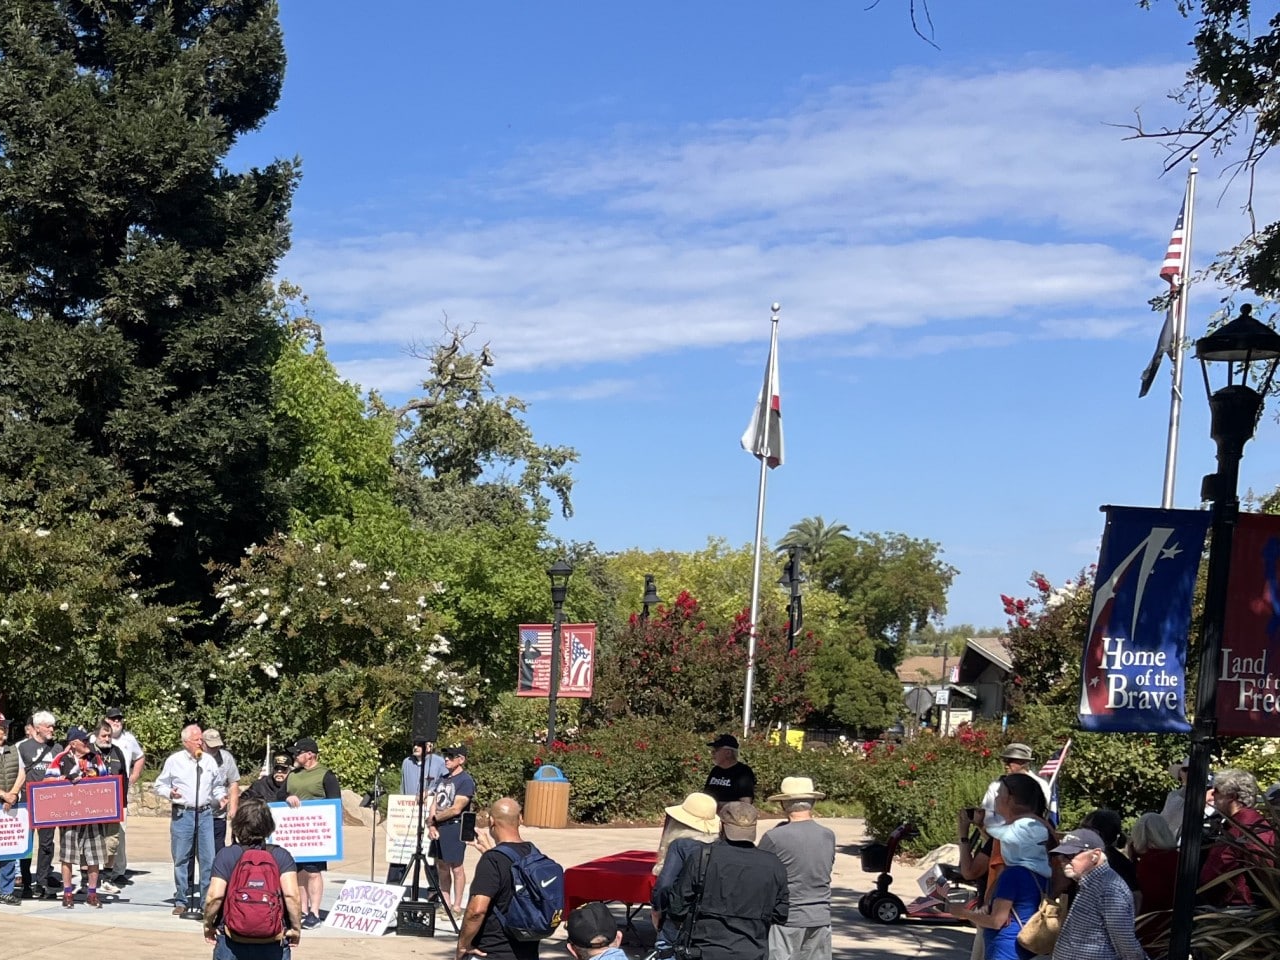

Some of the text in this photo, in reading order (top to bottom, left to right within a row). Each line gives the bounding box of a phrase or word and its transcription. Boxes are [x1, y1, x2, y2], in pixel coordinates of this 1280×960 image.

[1097, 637, 1167, 670] Home
[1218, 649, 1267, 681] Land
[1135, 669, 1178, 687] of the
[1257, 673, 1272, 689] of
[1104, 674, 1177, 710] Brave
[340, 885, 398, 909] PATRIOTS
[335, 904, 362, 914] STAND
[362, 906, 373, 916] UP
[332, 913, 382, 933] TYRANT
